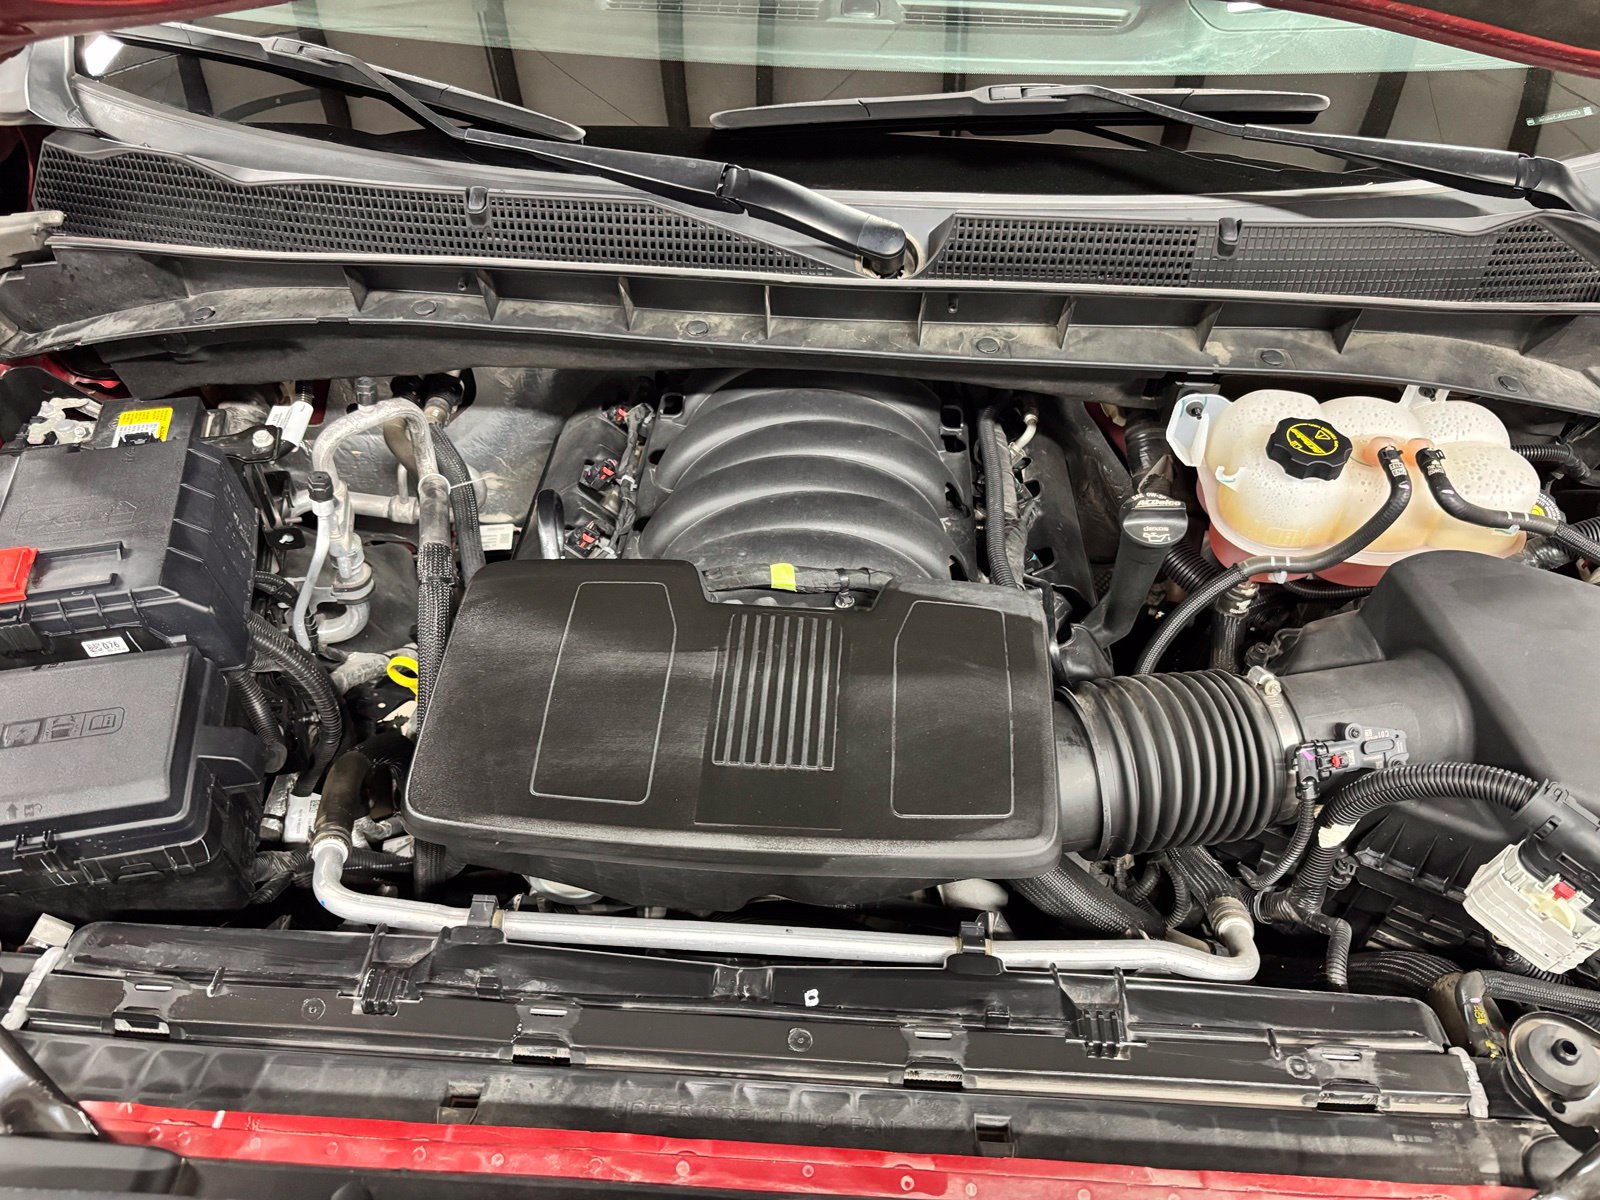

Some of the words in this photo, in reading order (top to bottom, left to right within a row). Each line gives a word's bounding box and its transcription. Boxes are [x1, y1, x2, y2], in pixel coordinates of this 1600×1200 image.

[1136, 499, 1181, 507] ACDelco
[612, 1100, 692, 1119] UPPER
[850, 1115, 896, 1136] FAN
